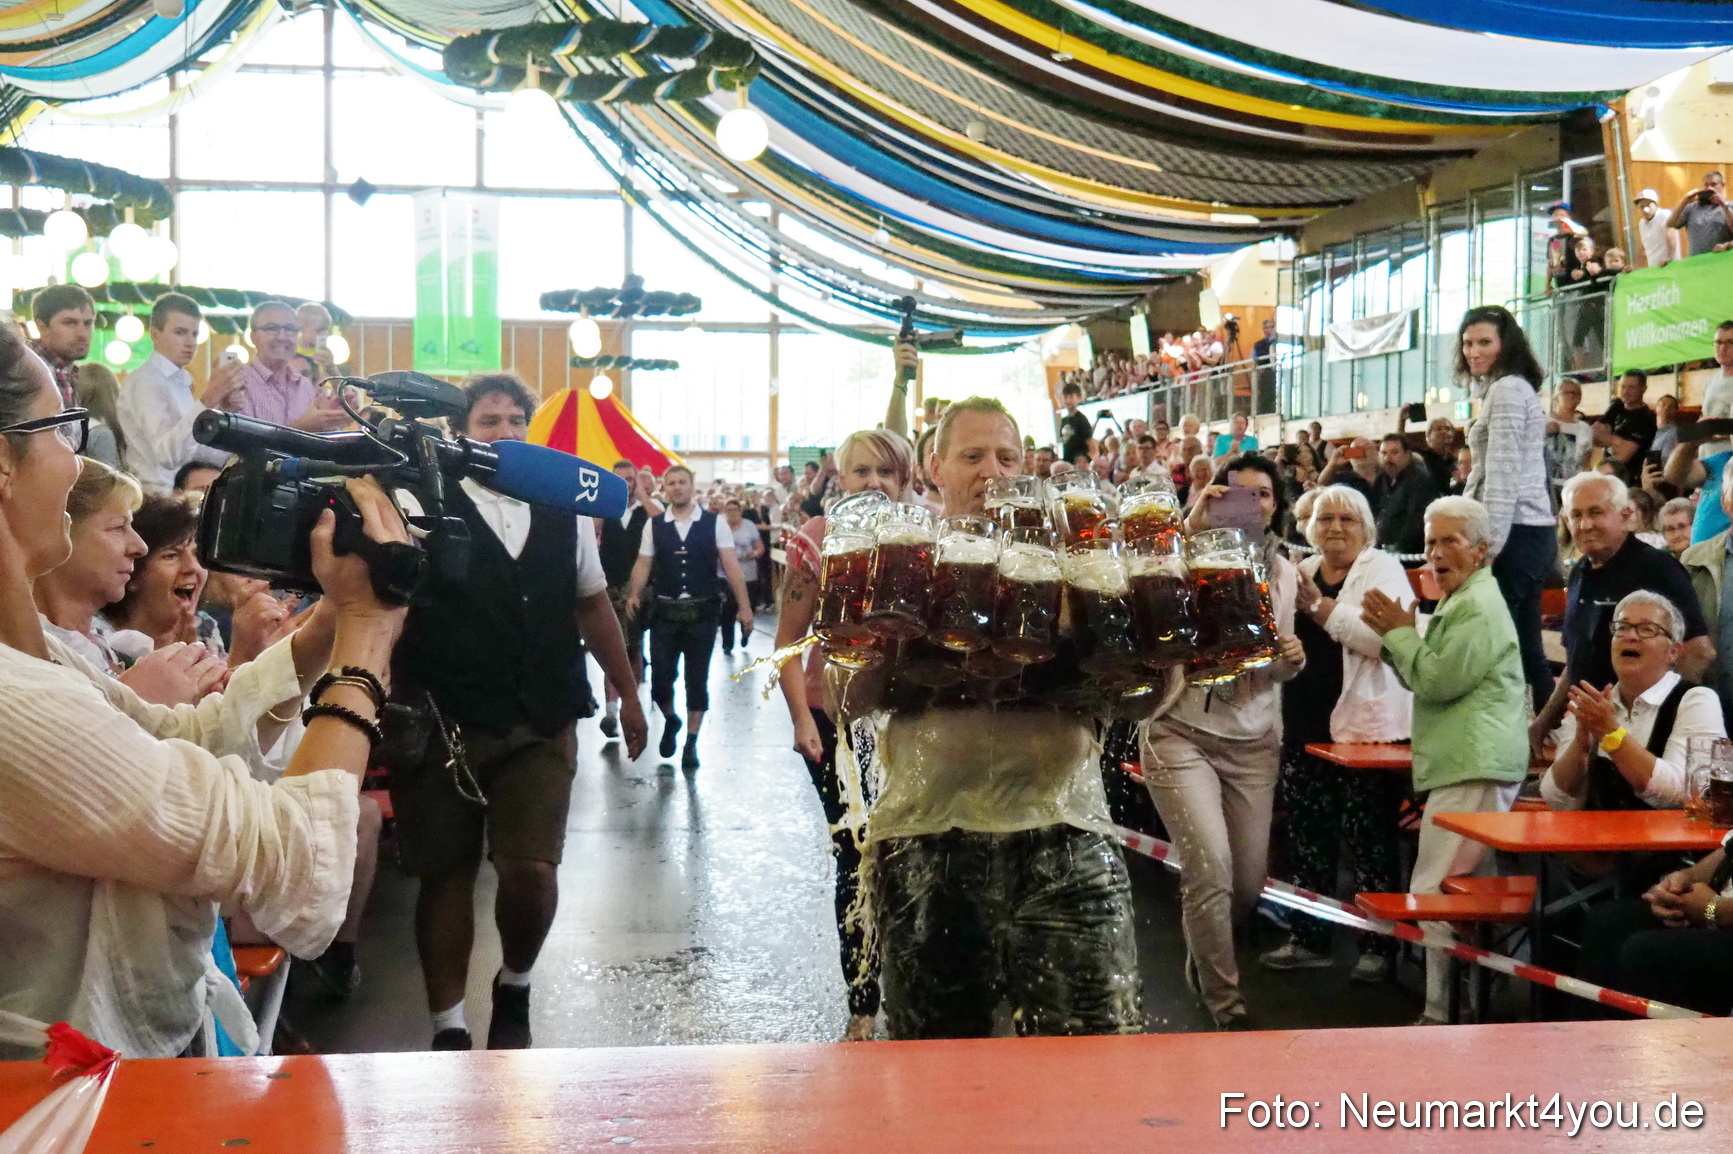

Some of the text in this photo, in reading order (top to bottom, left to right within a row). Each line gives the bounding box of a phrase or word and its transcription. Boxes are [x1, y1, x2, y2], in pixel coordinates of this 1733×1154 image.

[1626, 281, 1680, 315] Herzlich
[1626, 318, 1708, 350] Willkommen
[575, 467, 599, 502] BR
